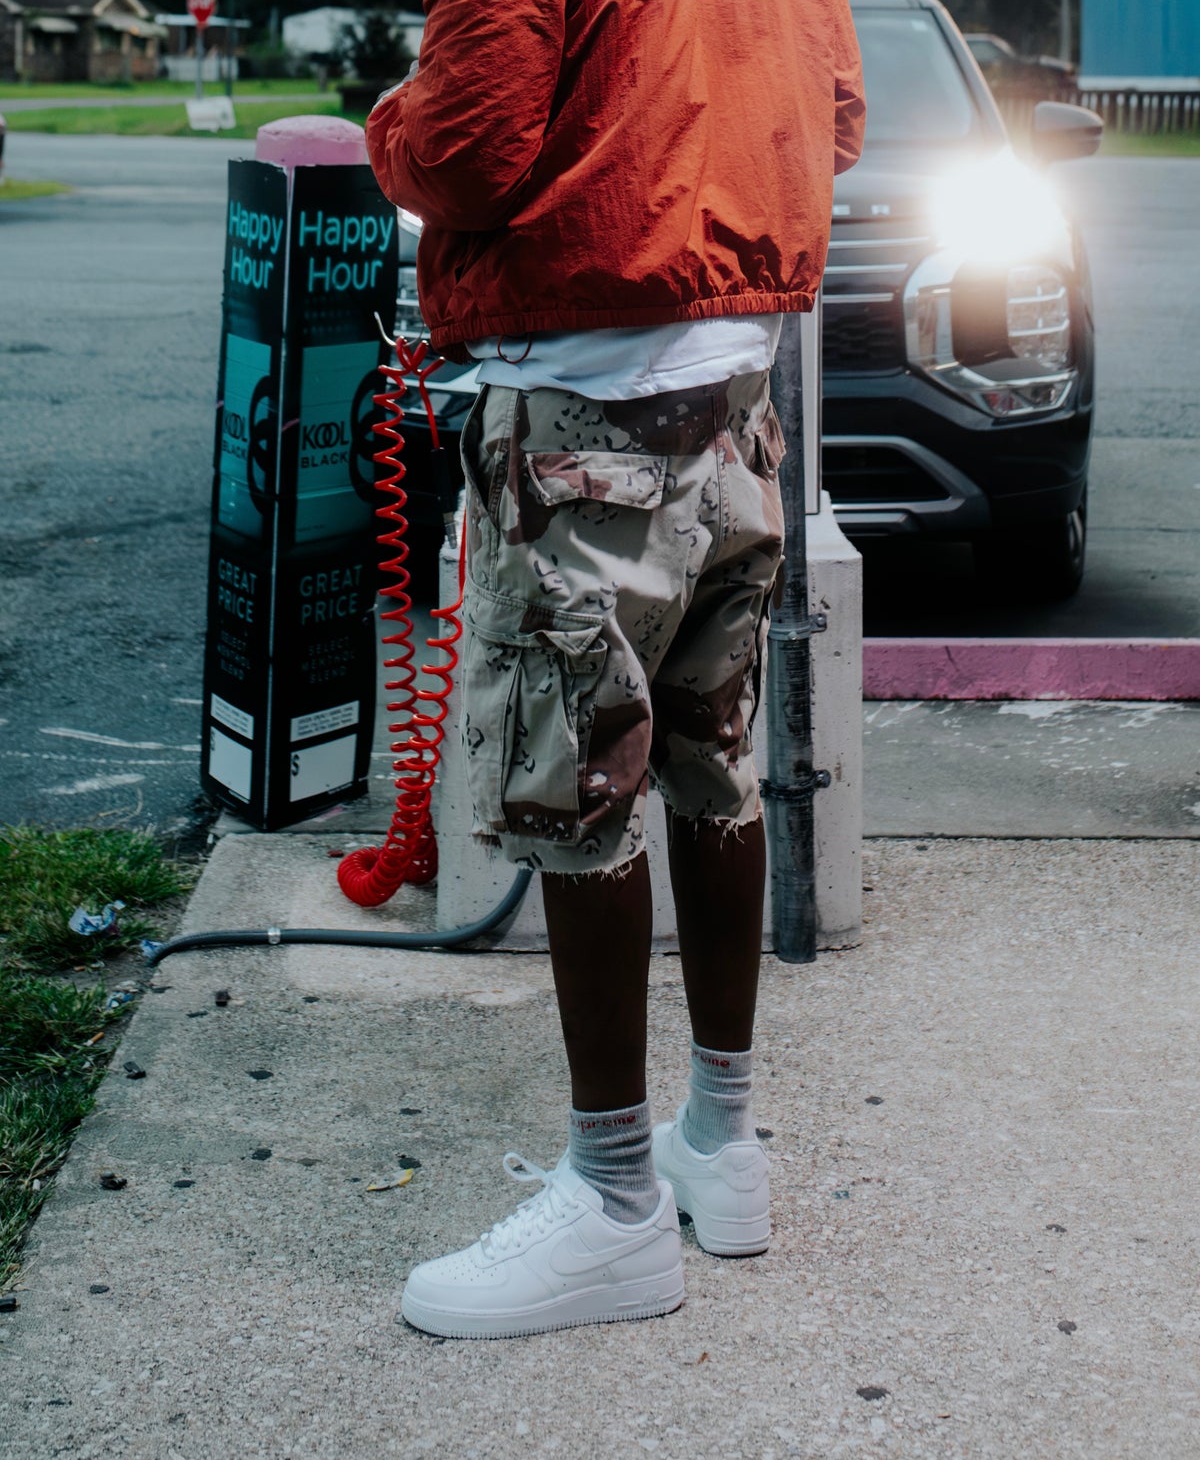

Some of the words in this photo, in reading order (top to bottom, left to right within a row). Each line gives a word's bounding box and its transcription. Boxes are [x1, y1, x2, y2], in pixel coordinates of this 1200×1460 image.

[228, 201, 284, 254] Happy
[299, 210, 394, 253] Happy
[231, 247, 274, 289] Hour
[308, 256, 383, 292] Hour
[302, 420, 349, 451] KOOL
[301, 450, 349, 469] BLACK
[217, 557, 258, 596] GREAT
[299, 564, 363, 598] GREAT
[217, 585, 254, 624] PRICE
[300, 592, 360, 626] PRICE
